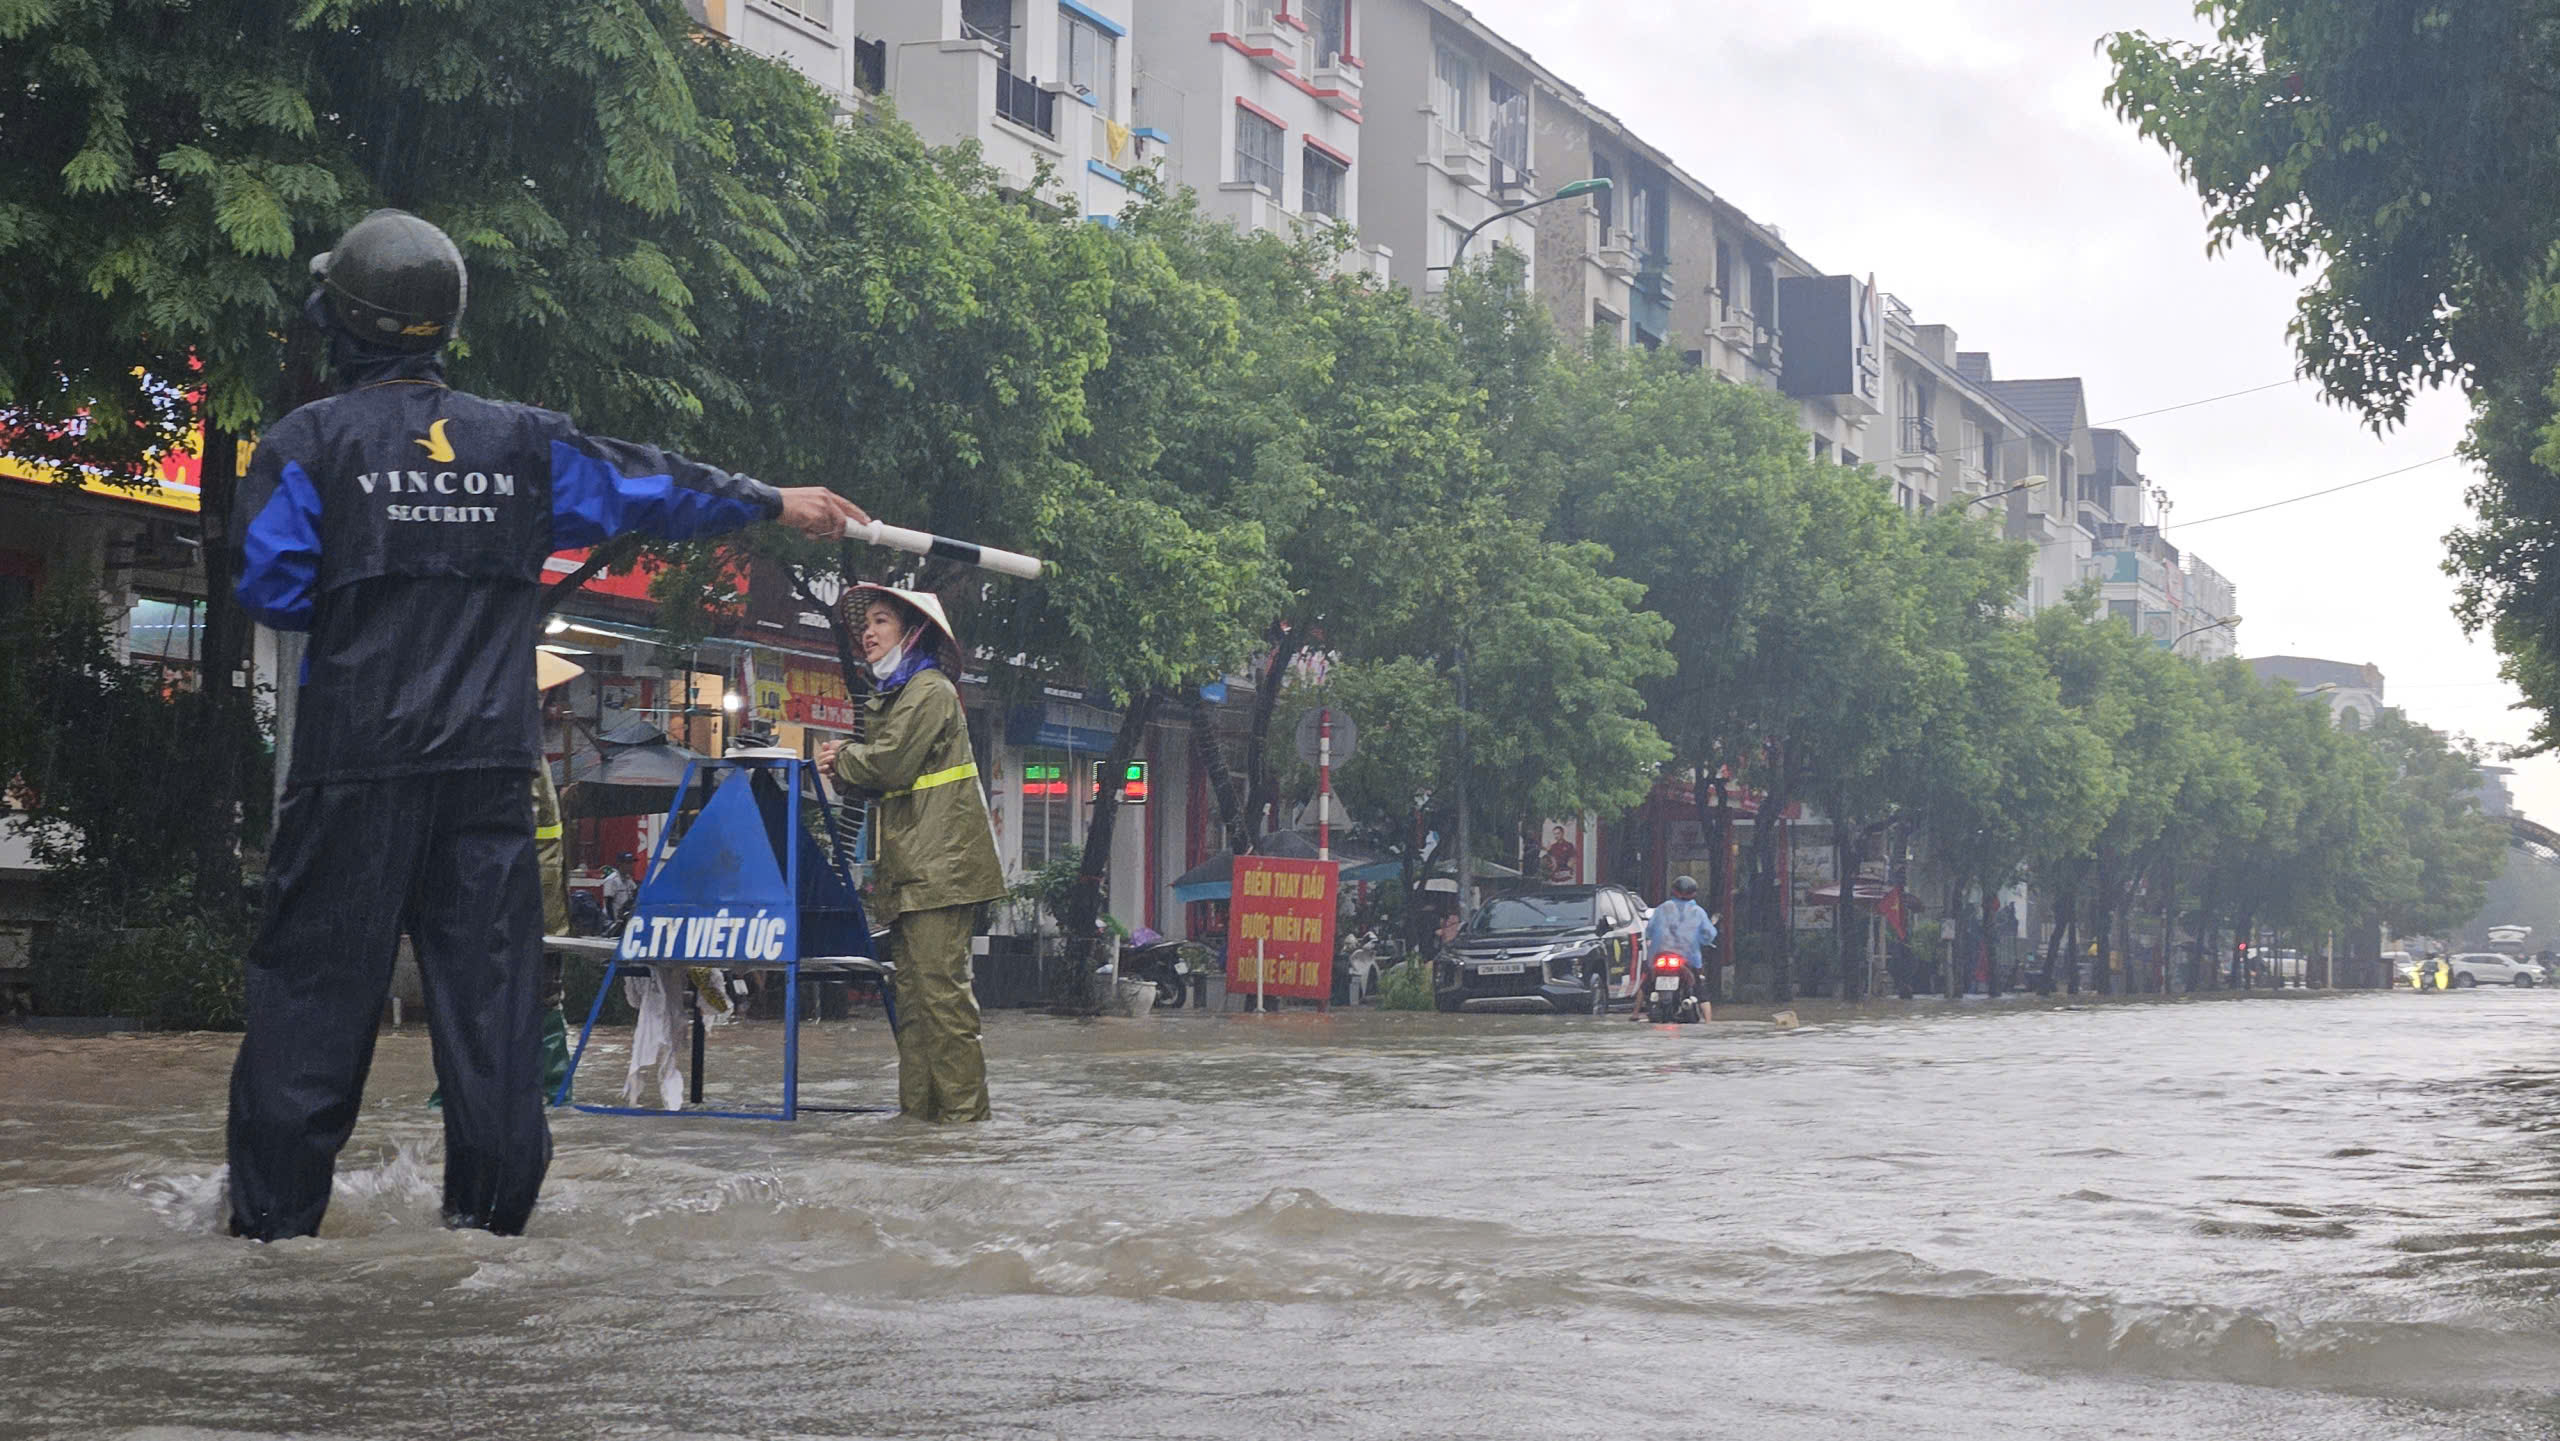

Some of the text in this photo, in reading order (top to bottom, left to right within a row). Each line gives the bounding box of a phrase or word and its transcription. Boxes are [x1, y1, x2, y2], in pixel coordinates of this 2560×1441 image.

[357, 470, 515, 496] VINCOM
[386, 504, 498, 523] SECURITY
[1273, 871, 1301, 899] THAY
[621, 915, 684, 960] C.TY
[744, 908, 787, 961] ÚC
